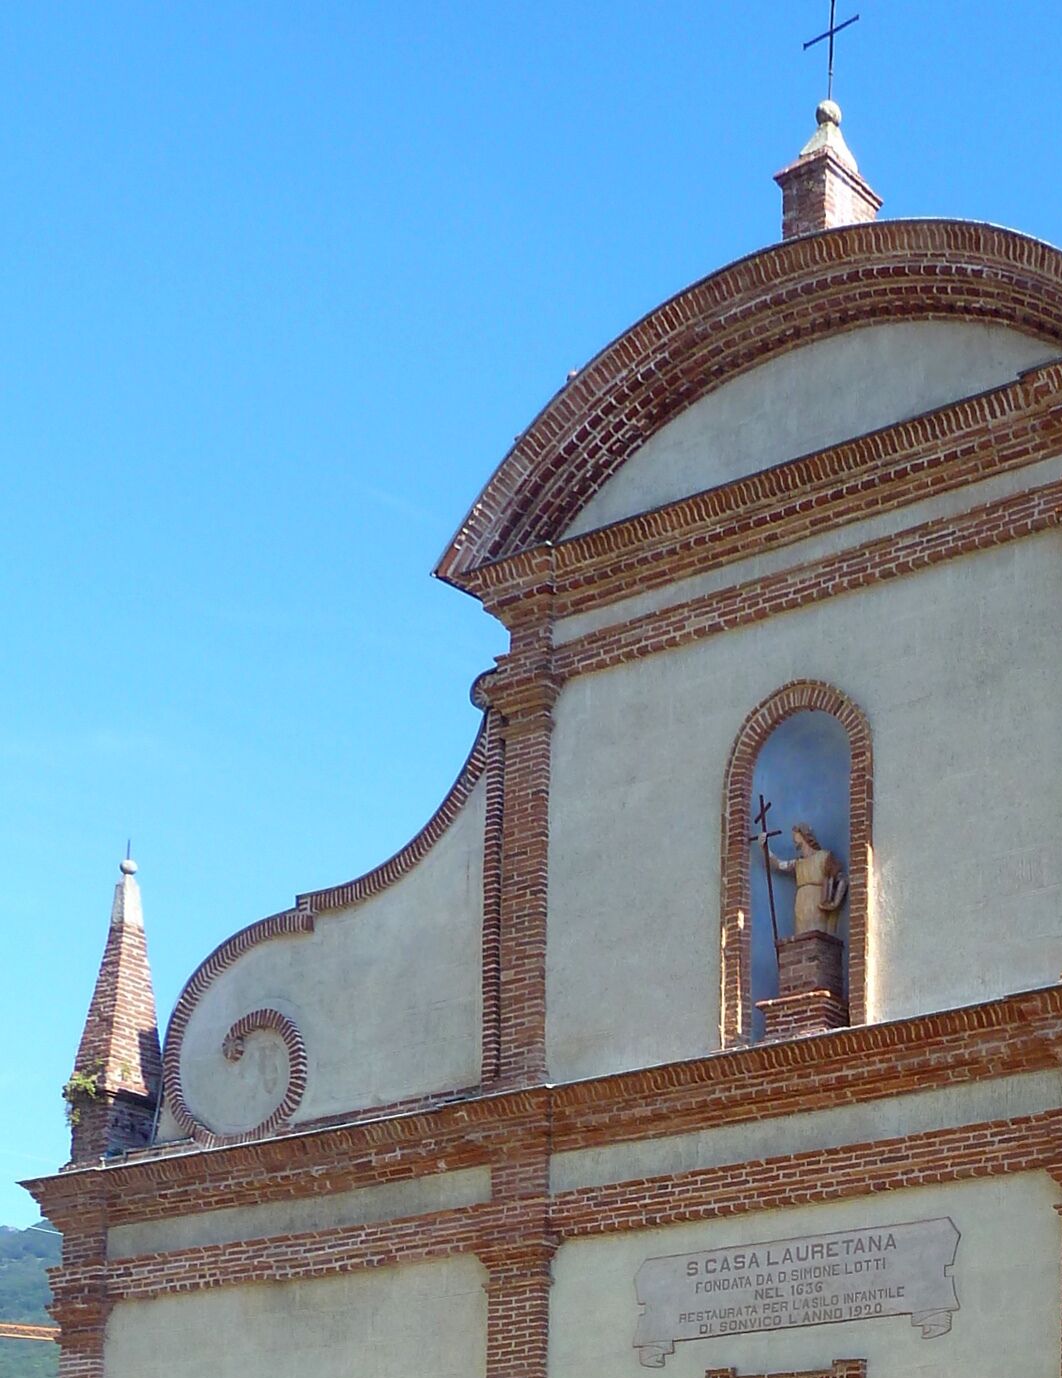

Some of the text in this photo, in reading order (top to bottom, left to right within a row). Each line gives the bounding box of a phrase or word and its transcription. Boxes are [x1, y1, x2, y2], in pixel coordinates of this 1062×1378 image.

[704, 1252, 760, 1274] CASA
[766, 1233, 897, 1267] LAURETANA
[695, 1275, 752, 1294] FONDATA
[756, 1273, 774, 1286] DA
[790, 1263, 841, 1282] SIMONE
[844, 1257, 886, 1275] LOTTI
[754, 1281, 824, 1300] NEL 1636
[679, 1286, 905, 1323] RESTAURATA PER L'ASILO INFANTILE
[699, 1323, 713, 1335] DI
[719, 1314, 782, 1333] SONVICO
[848, 1302, 883, 1318] 1920
